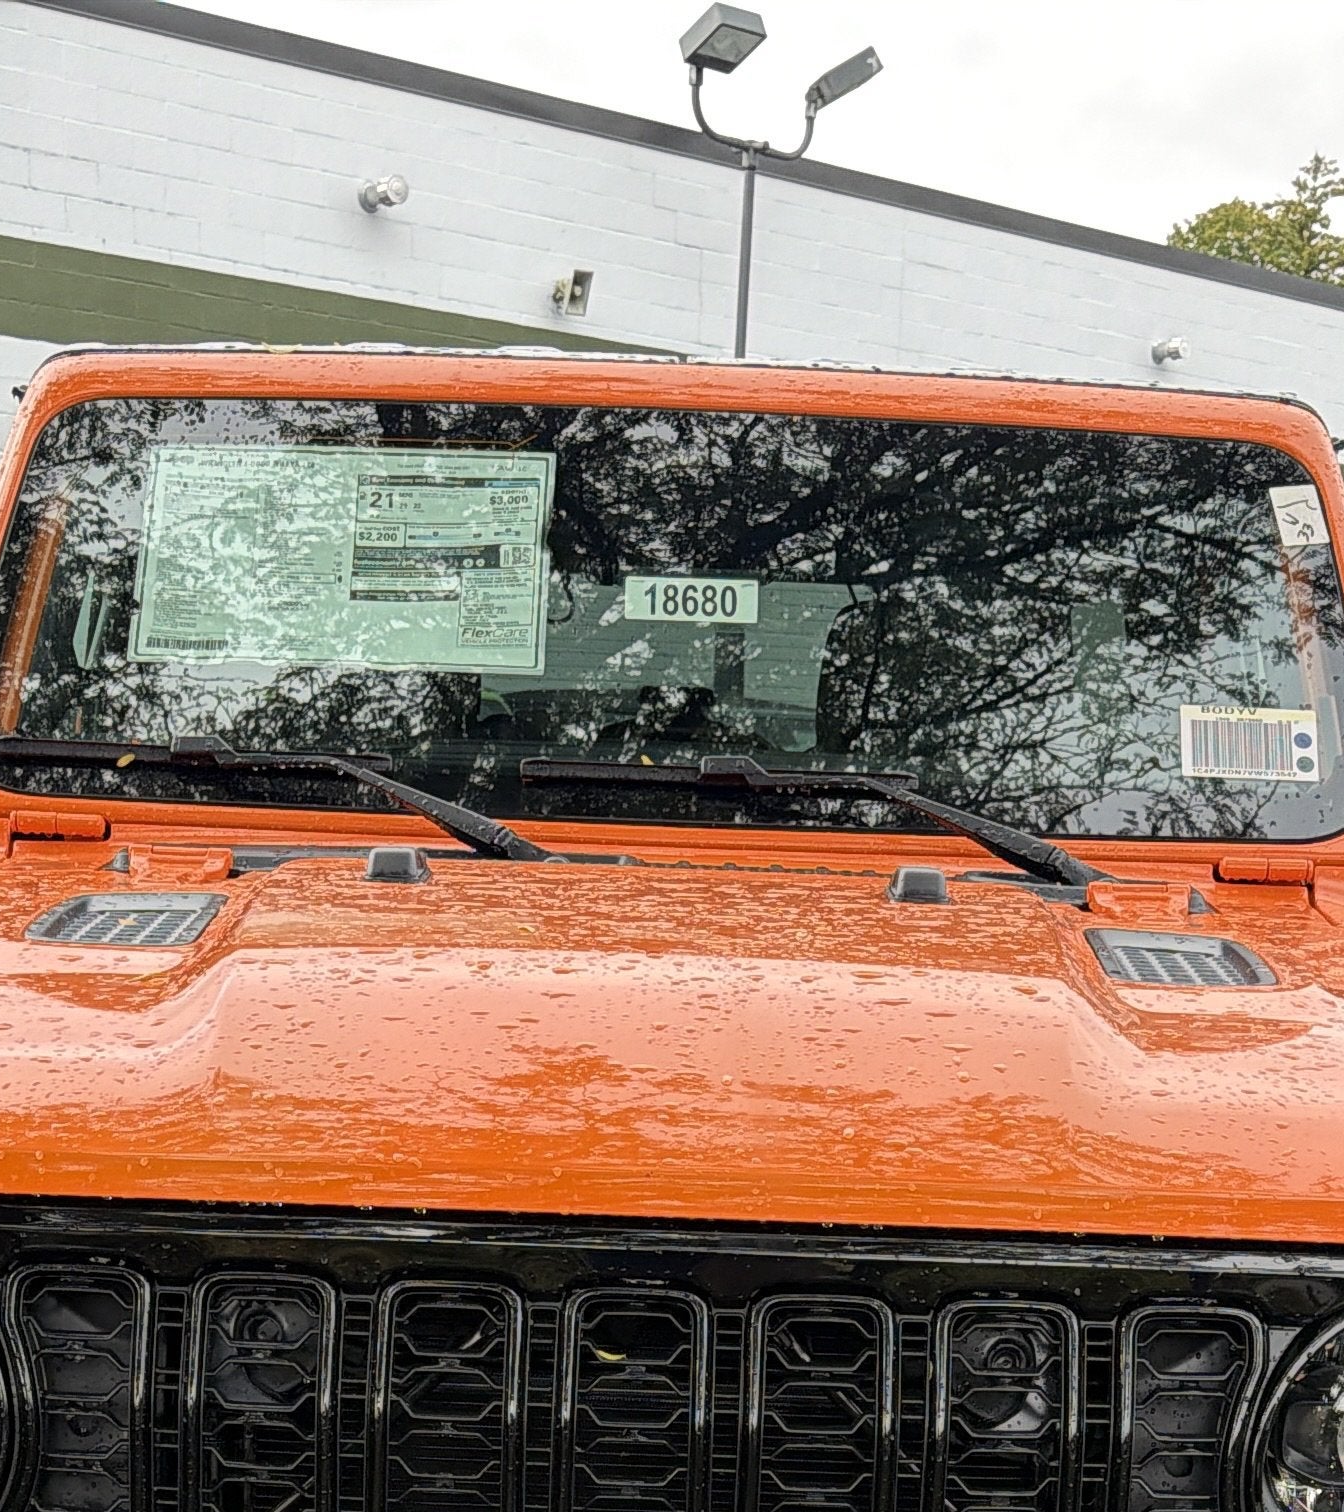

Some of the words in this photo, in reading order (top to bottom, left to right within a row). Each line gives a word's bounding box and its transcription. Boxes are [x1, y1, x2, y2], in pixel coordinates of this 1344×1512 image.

[369, 491, 394, 509] 21
[489, 495, 529, 506] $3,000
[358, 531, 398, 542] $2,200
[644, 583, 737, 617] 18680
[461, 627, 529, 638] FlexCare
